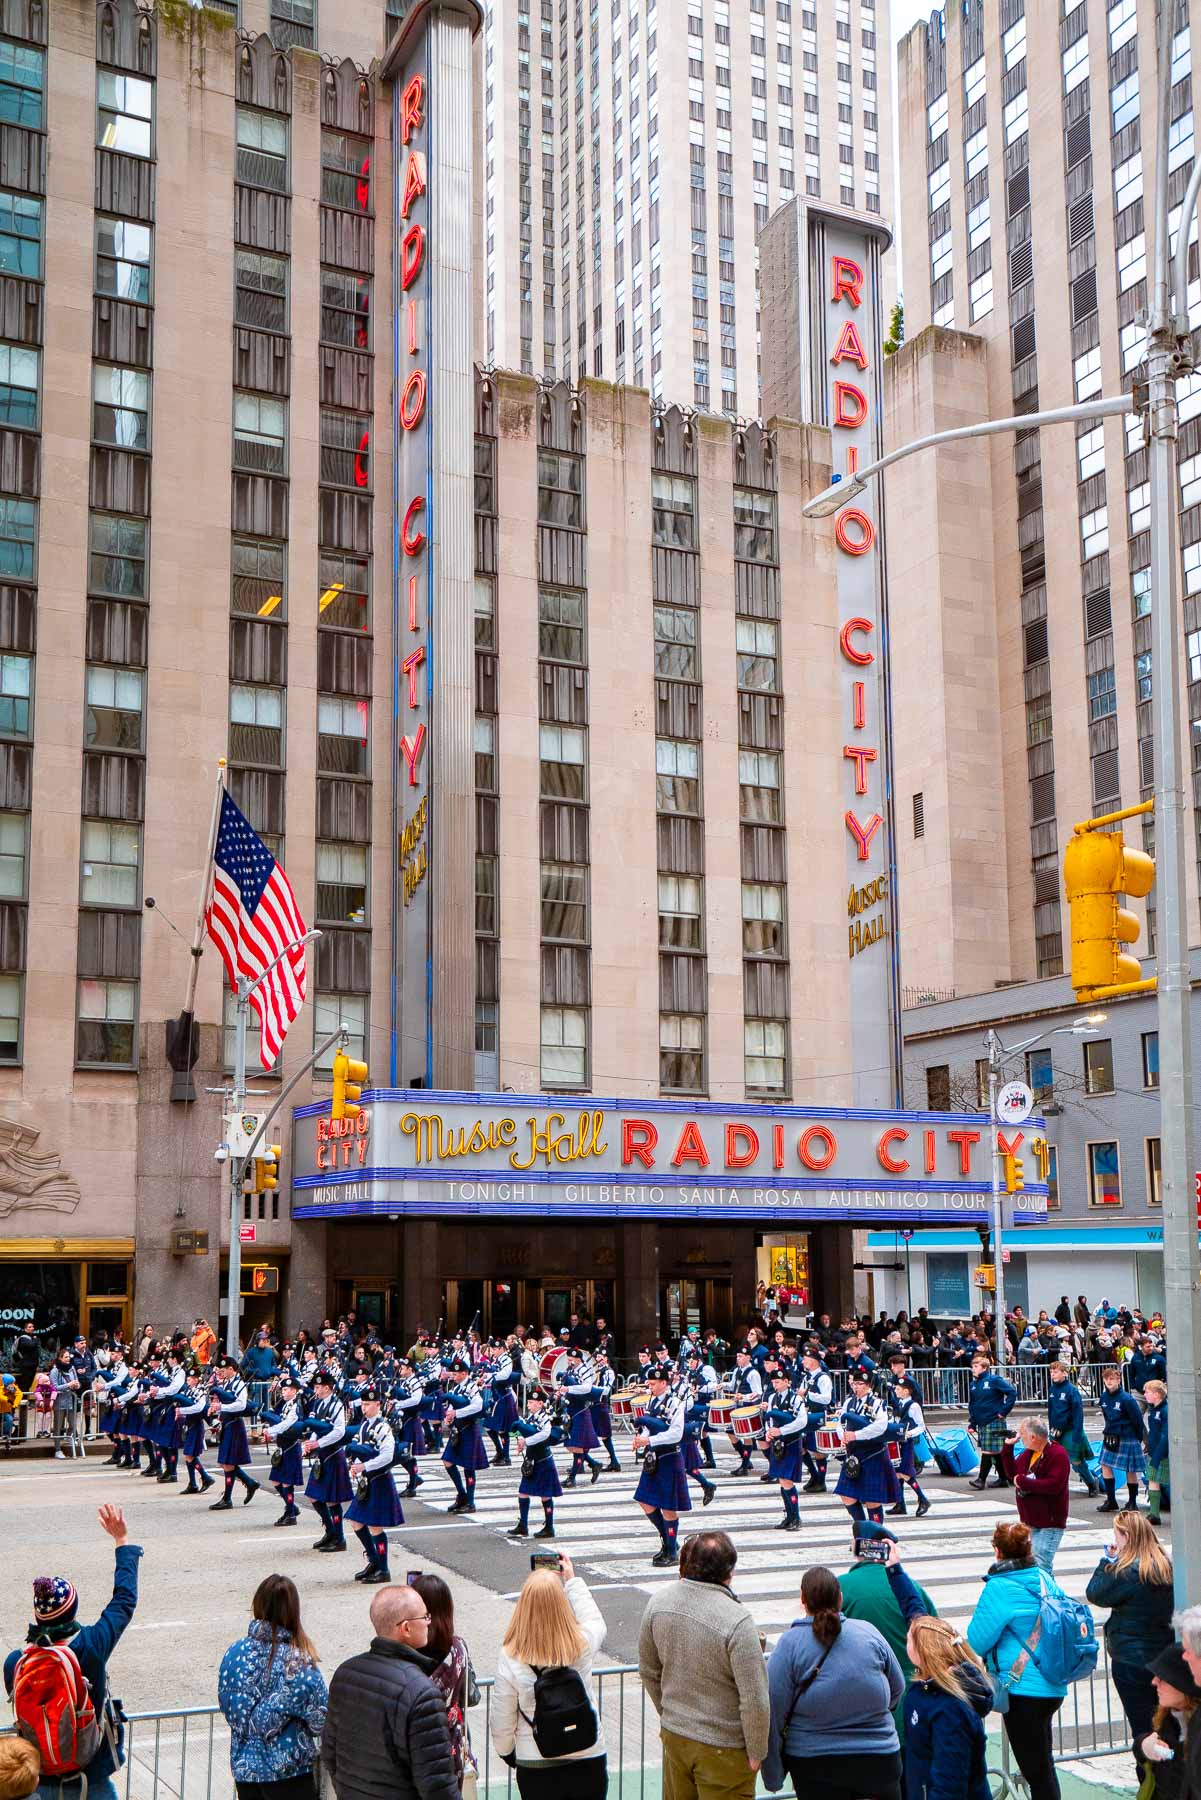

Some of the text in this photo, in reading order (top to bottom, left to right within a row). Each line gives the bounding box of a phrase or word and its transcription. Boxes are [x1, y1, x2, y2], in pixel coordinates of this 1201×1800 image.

[400, 73, 426, 432] RADIO
[831, 255, 875, 557] RADIO
[400, 495, 427, 788] CITY
[840, 616, 884, 861] CITY
[848, 914, 888, 959] HALL
[317, 1109, 368, 1141] RADIO
[400, 1110, 608, 1170] Music Hall
[622, 1118, 838, 1172] RADIO
[877, 1127, 1025, 1174] CITY
[317, 1140, 367, 1169] CITY
[313, 1183, 372, 1203] MUSIC HALL
[448, 1183, 537, 1201] TONIGHT
[566, 1185, 664, 1203] GILBERTO
[679, 1187, 740, 1204] SANTA
[754, 1189, 804, 1206] ROSA
[829, 1192, 929, 1208] AUTENTICO
[942, 1193, 985, 1209] TOUR
[0, 1308, 35, 1320] OON
